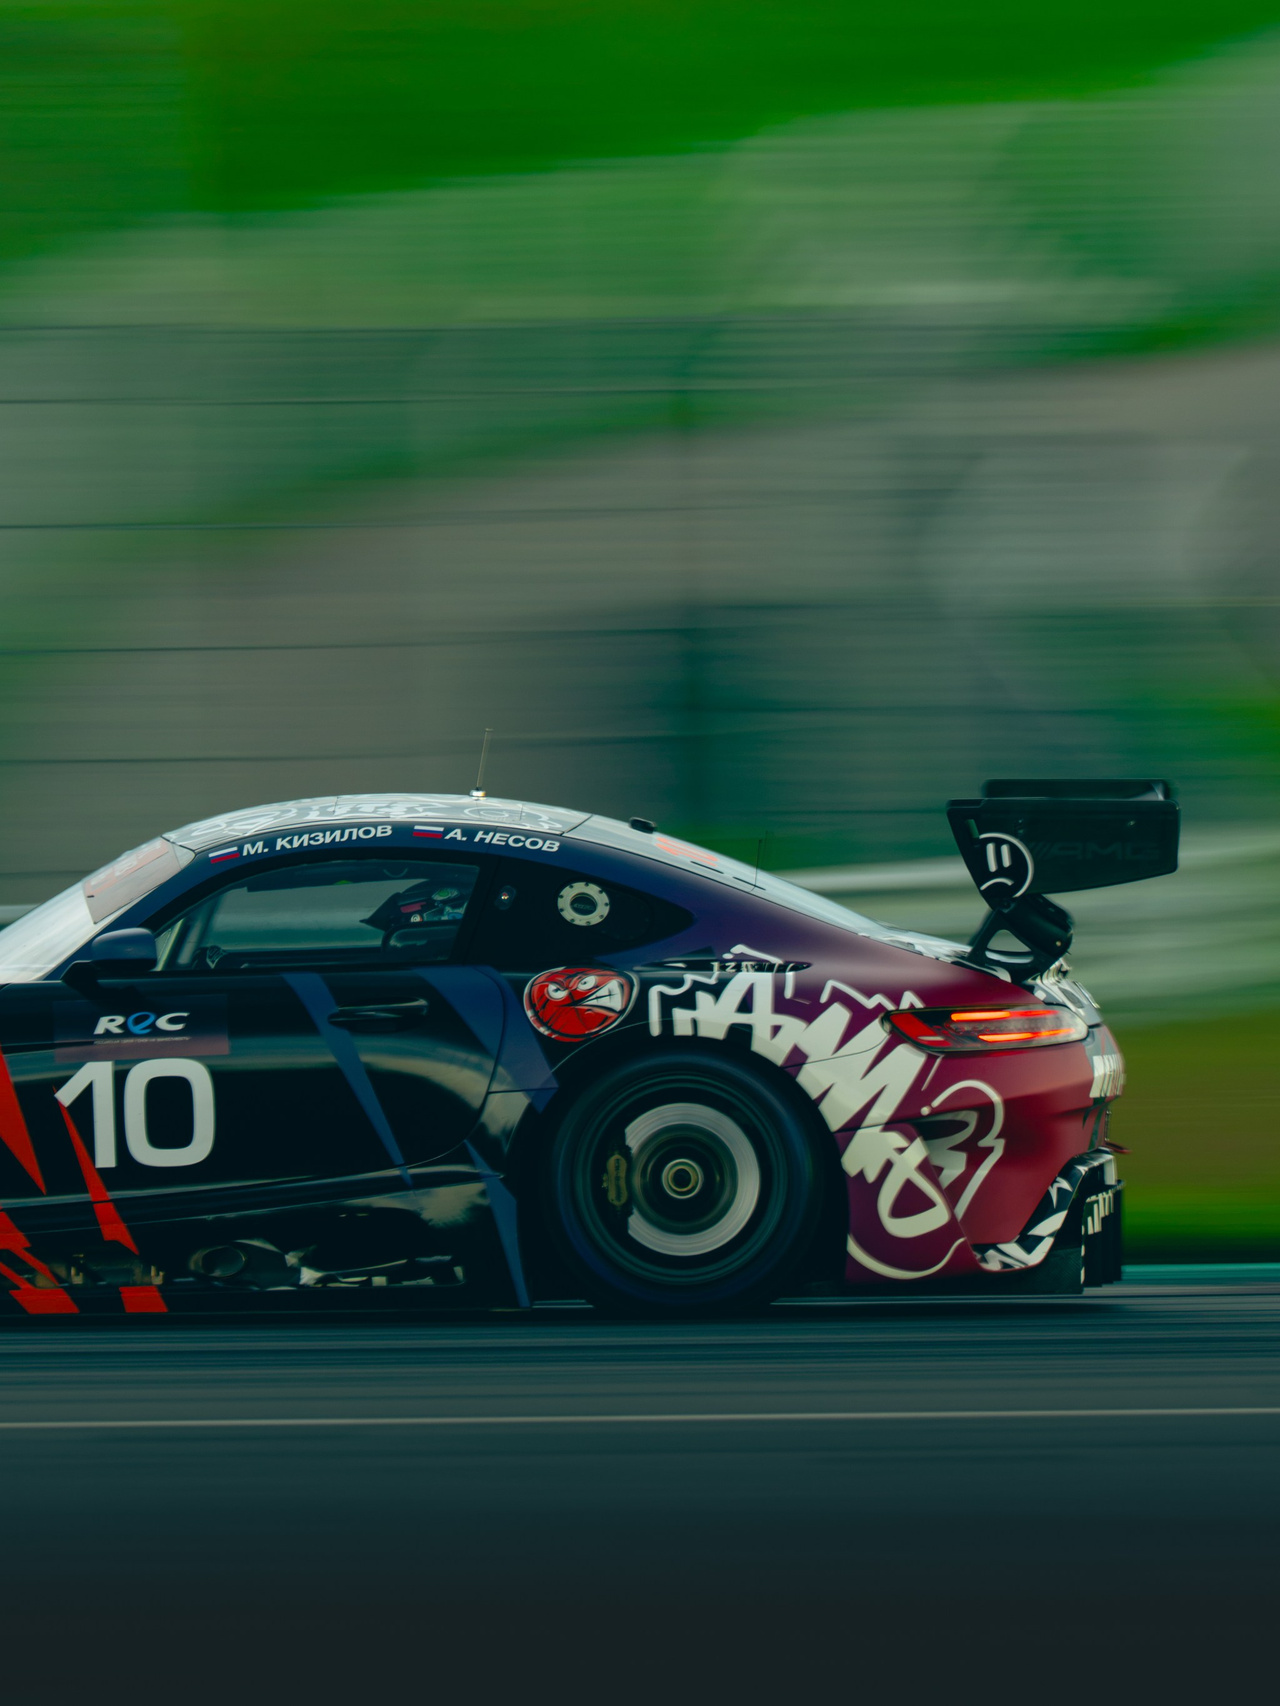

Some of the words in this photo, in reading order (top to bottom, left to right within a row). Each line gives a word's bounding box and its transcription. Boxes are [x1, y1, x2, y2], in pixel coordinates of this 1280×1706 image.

[242, 840, 269, 857] М.
[275, 824, 393, 850] КИЗИЛОВ
[444, 828, 467, 842] А.
[473, 830, 561, 853] НЕСОВ
[54, 1057, 216, 1168] 10
